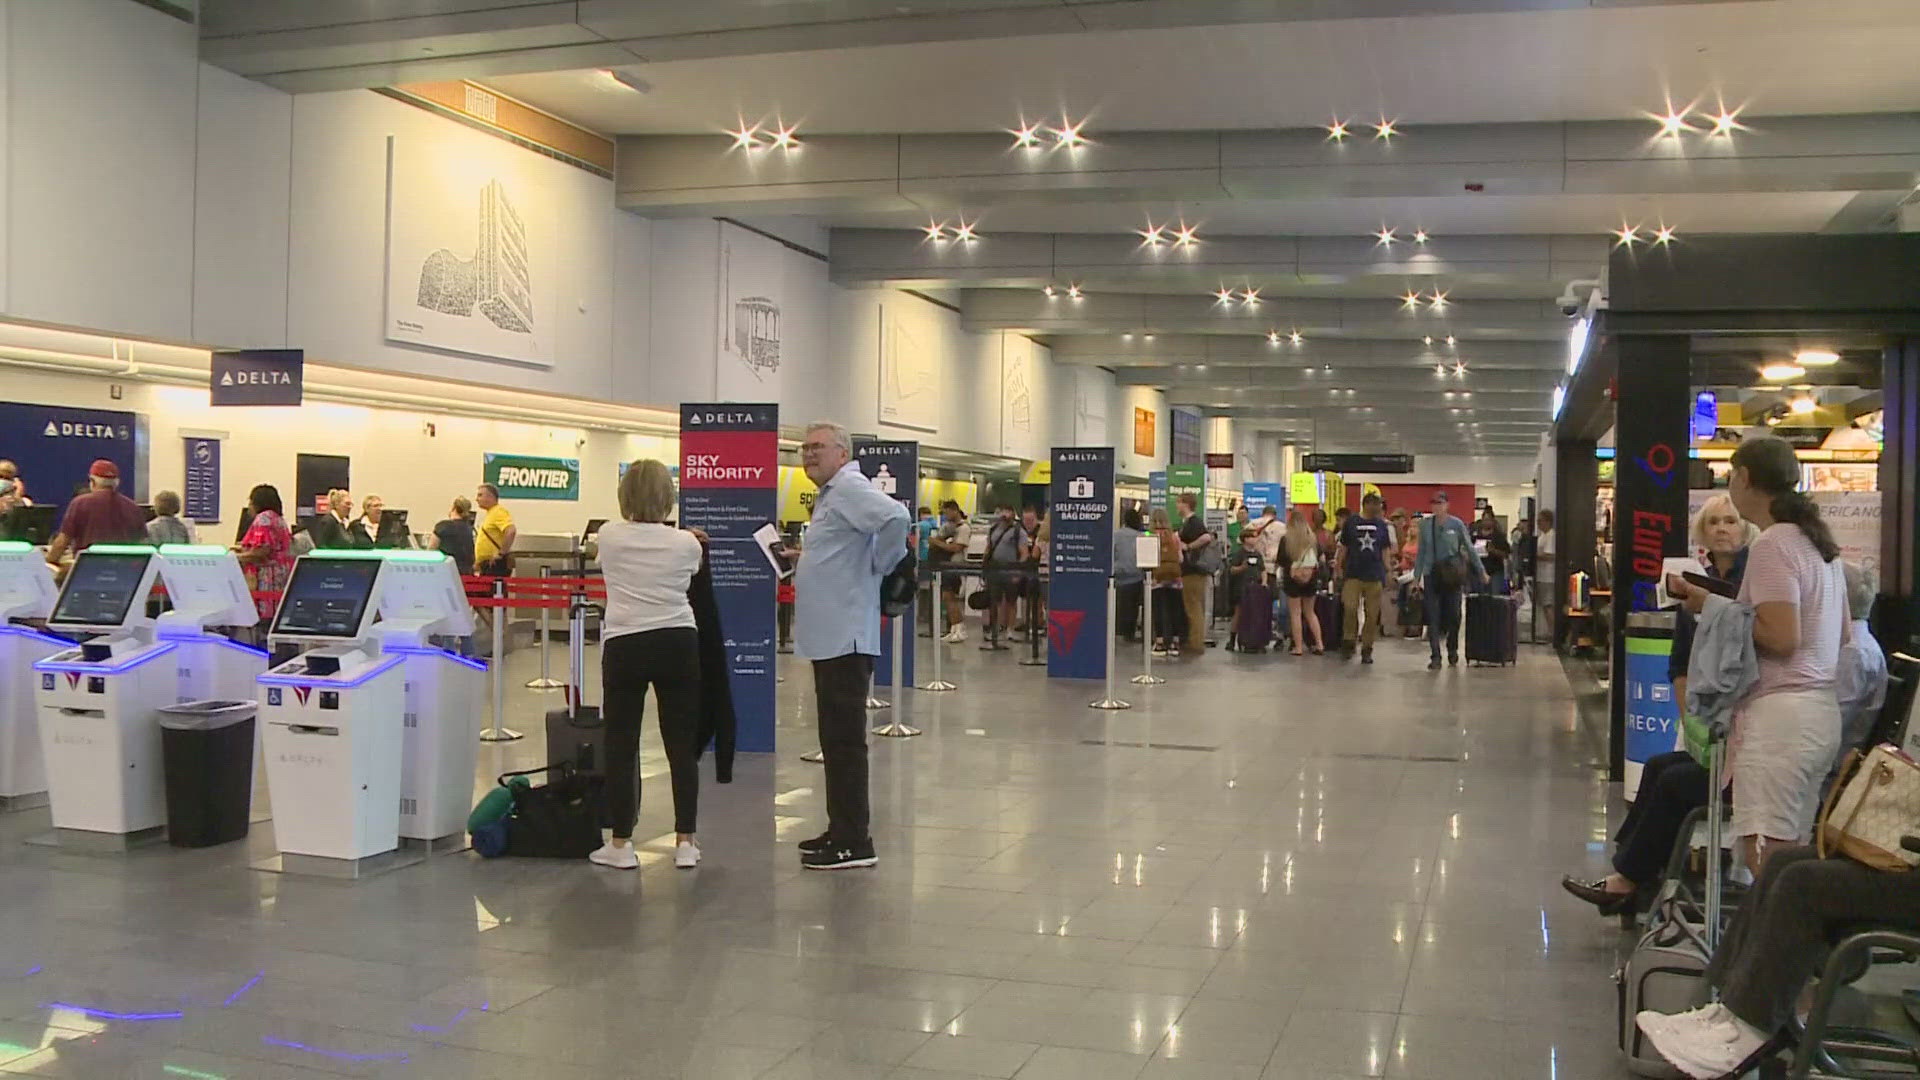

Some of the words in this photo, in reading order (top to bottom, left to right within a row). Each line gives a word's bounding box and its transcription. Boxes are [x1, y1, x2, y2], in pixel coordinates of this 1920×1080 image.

[236, 371, 292, 385] DELTA
[705, 413, 754, 424] DELTA
[62, 422, 115, 438] DELTA
[868, 446, 901, 455] DELTA
[1068, 453, 1098, 461] DELTA
[686, 454, 720, 467] SKY
[497, 466, 569, 489] FRONTIER
[686, 467, 764, 480] PRIORITY
[1055, 503, 1108, 513] SELF-TAGGED
[1061, 513, 1078, 521] BAG
[1079, 513, 1102, 521] DROP
[1628, 714, 1671, 733] RECY
